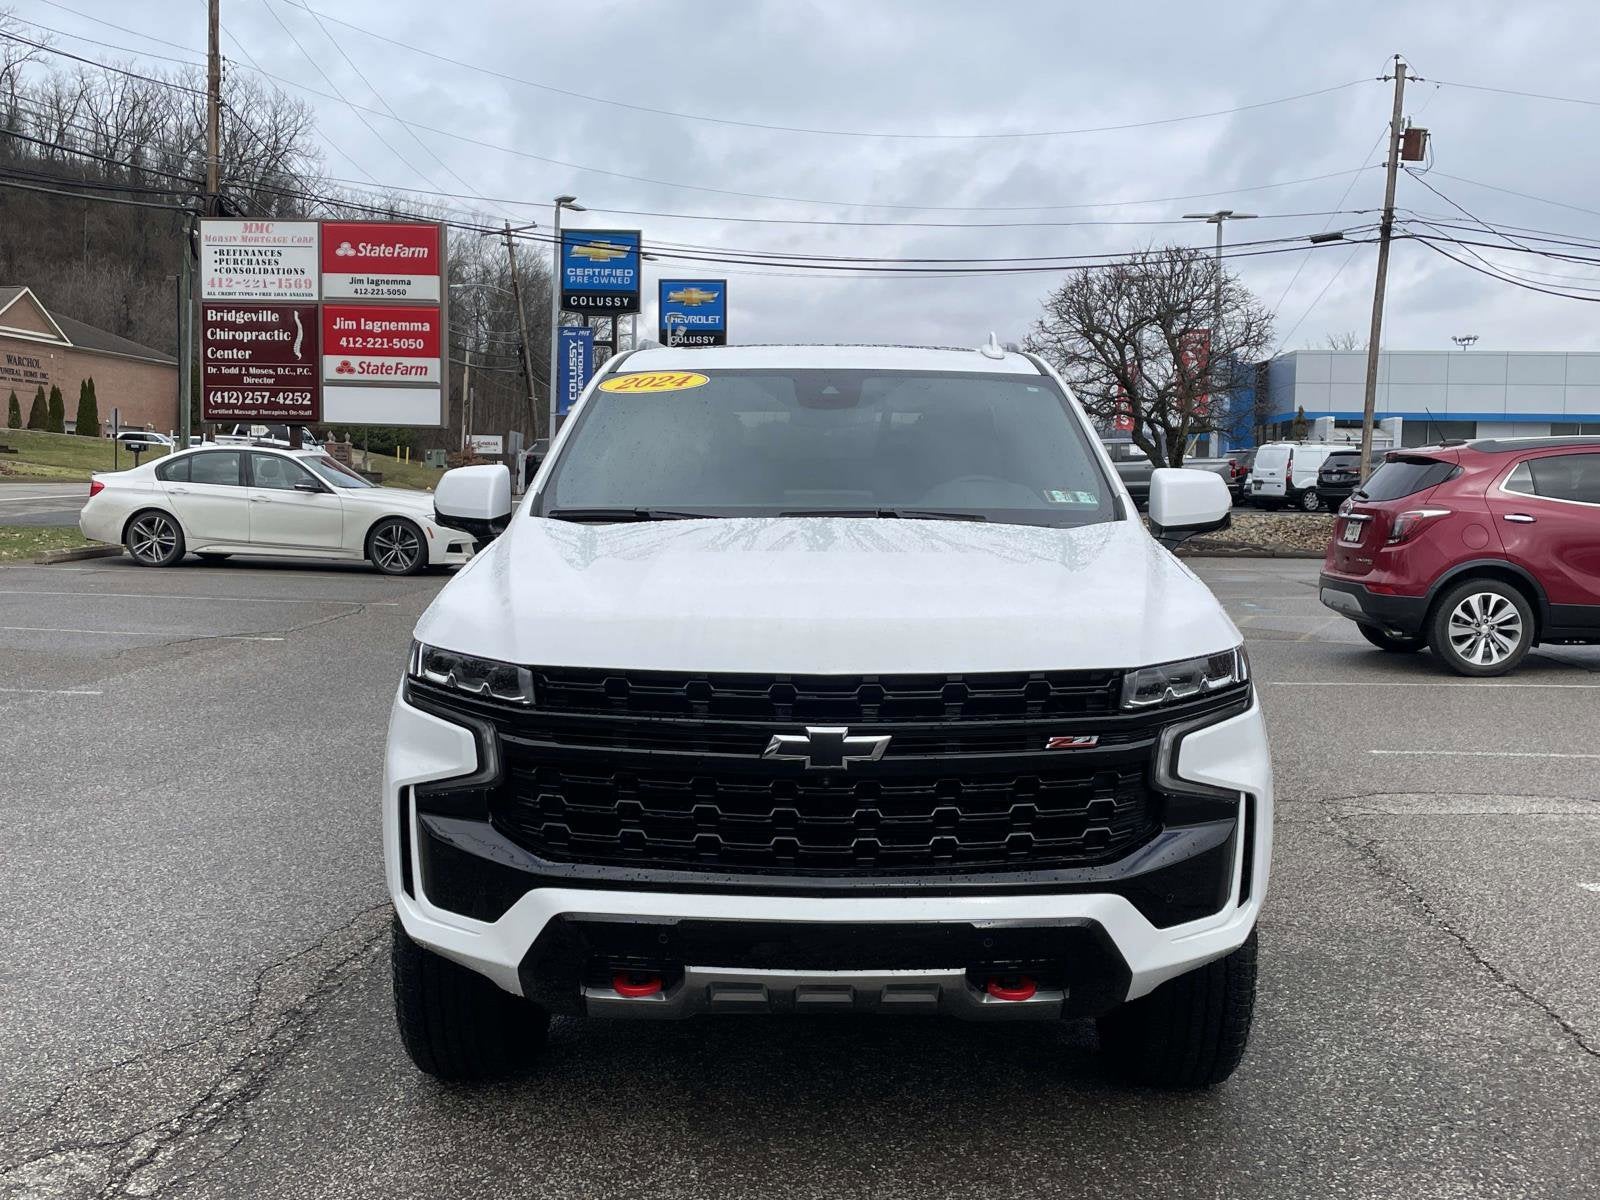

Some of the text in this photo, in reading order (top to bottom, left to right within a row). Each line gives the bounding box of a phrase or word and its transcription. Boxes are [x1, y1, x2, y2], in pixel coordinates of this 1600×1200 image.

[242, 223, 274, 233] MMC
[219, 249, 282, 257] REFINANCES
[219, 258, 279, 266] PURCHASES
[219, 267, 305, 275] CONSOLIDATIONS
[567, 268, 633, 276] CERTIFIED
[207, 278, 312, 289] 412-221-1569
[349, 277, 411, 286] Jim Iagnemma
[570, 276, 630, 284] PRE-OWNED
[354, 288, 406, 296] 412-221-5050
[570, 296, 629, 306] COLUSSY
[207, 310, 279, 324] Bridgeville
[333, 318, 430, 332] Jim Iagnemma
[207, 328, 291, 342] Chiropractic
[671, 336, 715, 344] COLUSSY
[340, 337, 424, 349] 412-221-5050
[207, 347, 252, 359] Center
[6, 354, 41, 368] WARCHOL
[0, 367, 21, 376] UNERAL
[569, 339, 577, 400] COLUSSY
[244, 376, 275, 384] Director
[615, 375, 693, 389] 2024
